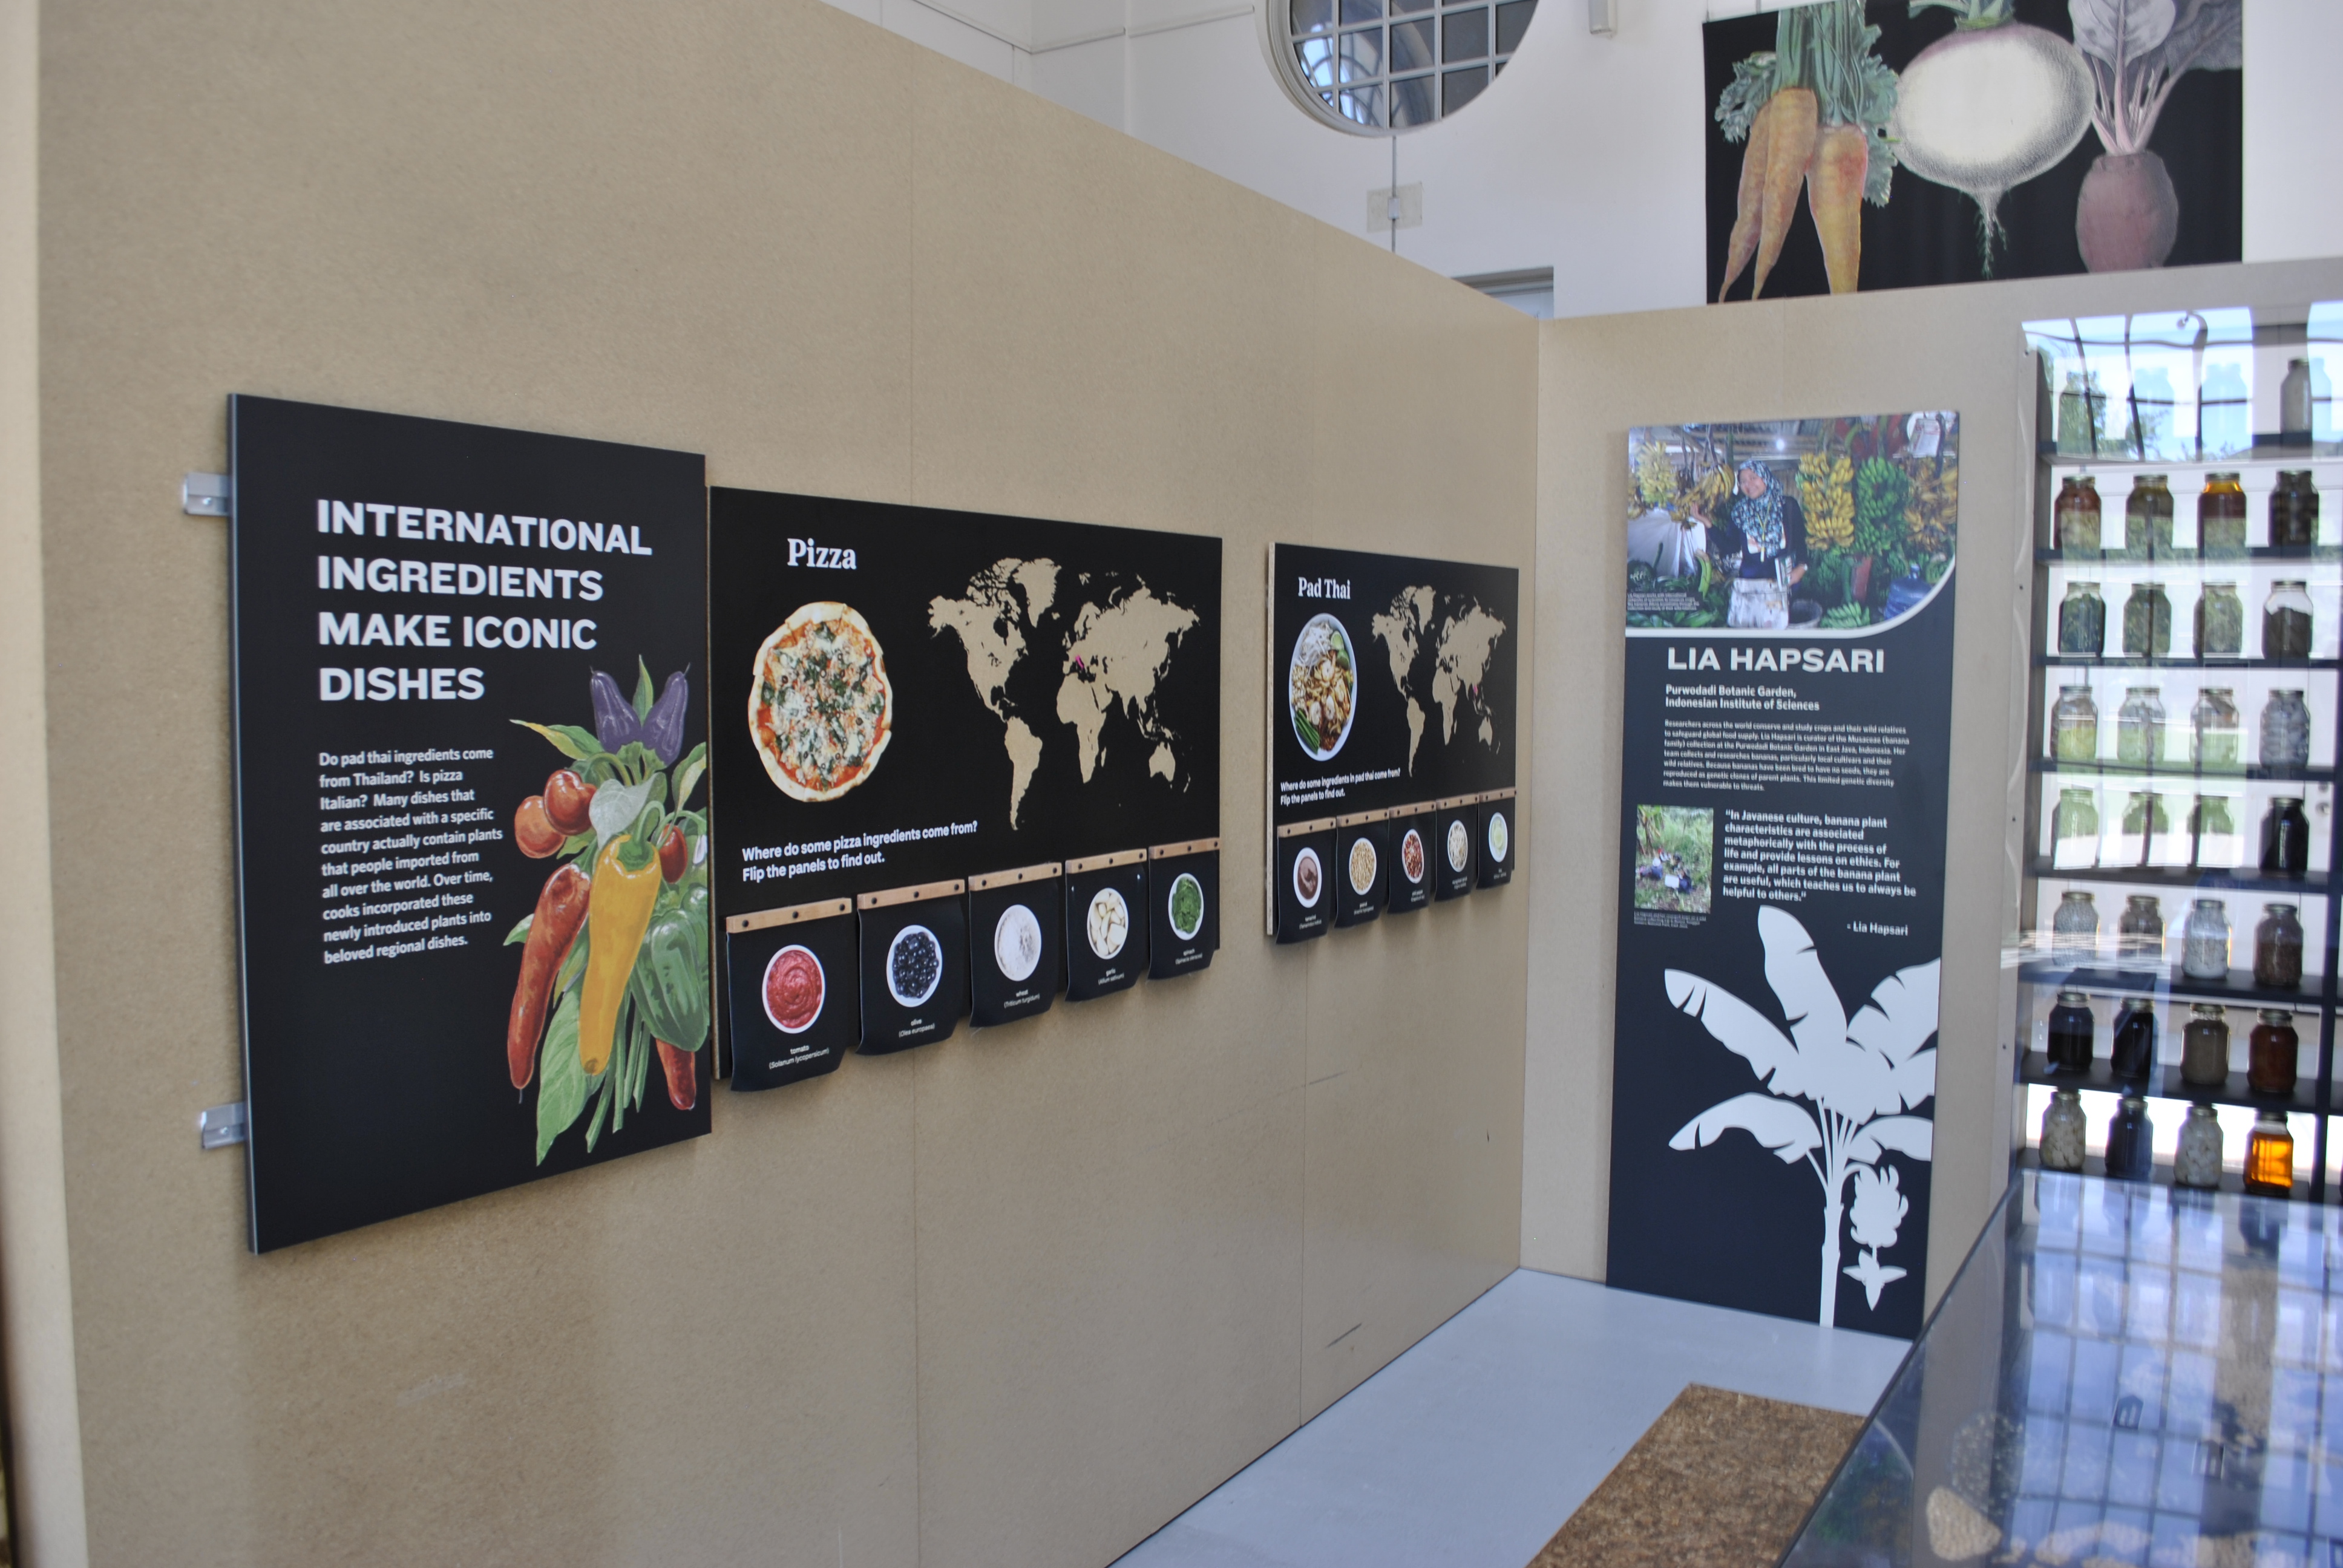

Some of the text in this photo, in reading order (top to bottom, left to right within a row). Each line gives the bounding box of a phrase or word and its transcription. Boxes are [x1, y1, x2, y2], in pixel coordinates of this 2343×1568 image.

[318, 500, 652, 554] INTERNATIONAL
[787, 538, 856, 569] Pizza
[318, 556, 603, 600] INGREDIENTS
[1298, 577, 1351, 599] Pad Thai
[319, 612, 597, 649] MAKE ICONIC
[1668, 647, 1884, 672] LIA HAPSARI
[320, 667, 484, 701] DISHES
[1666, 684, 1797, 698] Purwodadi Botanic Garden,
[1665, 696, 1820, 710] Indonesian Institute of Sciences
[319, 748, 493, 767] Do pad thai ingredients come
[319, 769, 463, 787] from Thailand? Is pizza
[1280, 782, 1299, 791] Where
[1299, 779, 1306, 789] do
[1306, 779, 1321, 788] some
[1321, 774, 1349, 787] ingredients
[1349, 773, 1355, 782] in
[1355, 772, 1365, 783] pad
[1365, 770, 1374, 780] thai
[1374, 771, 1387, 779] come
[320, 789, 474, 809] Italian? Many dishes that
[1280, 788, 1345, 806] Flip the panels to find out.
[320, 808, 494, 832] are associated with a specific
[1742, 810, 1784, 822] Javanese
[1786, 812, 1822, 825] culture,
[1824, 814, 1860, 826] banana
[1861, 816, 1887, 828] plant
[321, 828, 503, 854] country actually contain plants
[742, 820, 977, 861] Where do some pizza ingredients come from?
[1725, 823, 1864, 840] characteristics are associated
[1725, 836, 1887, 854] metaphorically with the process of
[321, 852, 479, 876] that people imported from
[742, 851, 885, 883] Flip the panels to find out.
[1724, 848, 1900, 868] life and provide lessons on ethics. For
[1723, 862, 1900, 882] example, all parts of the banana plant
[322, 871, 493, 898] all over the world. Over time,
[1723, 875, 1916, 897] are useful, which teaches us to always be
[1723, 886, 1755, 898] helpful
[1757, 888, 1766, 898] to
[323, 893, 473, 920] cooks incorporated these
[323, 911, 491, 941] newly introduced plants into
[1853, 921, 1867, 932] Lia
[1869, 923, 1908, 935] Hapsari
[324, 936, 468, 964] beloved regional dishes.
[790, 1045, 809, 1054] tomato
